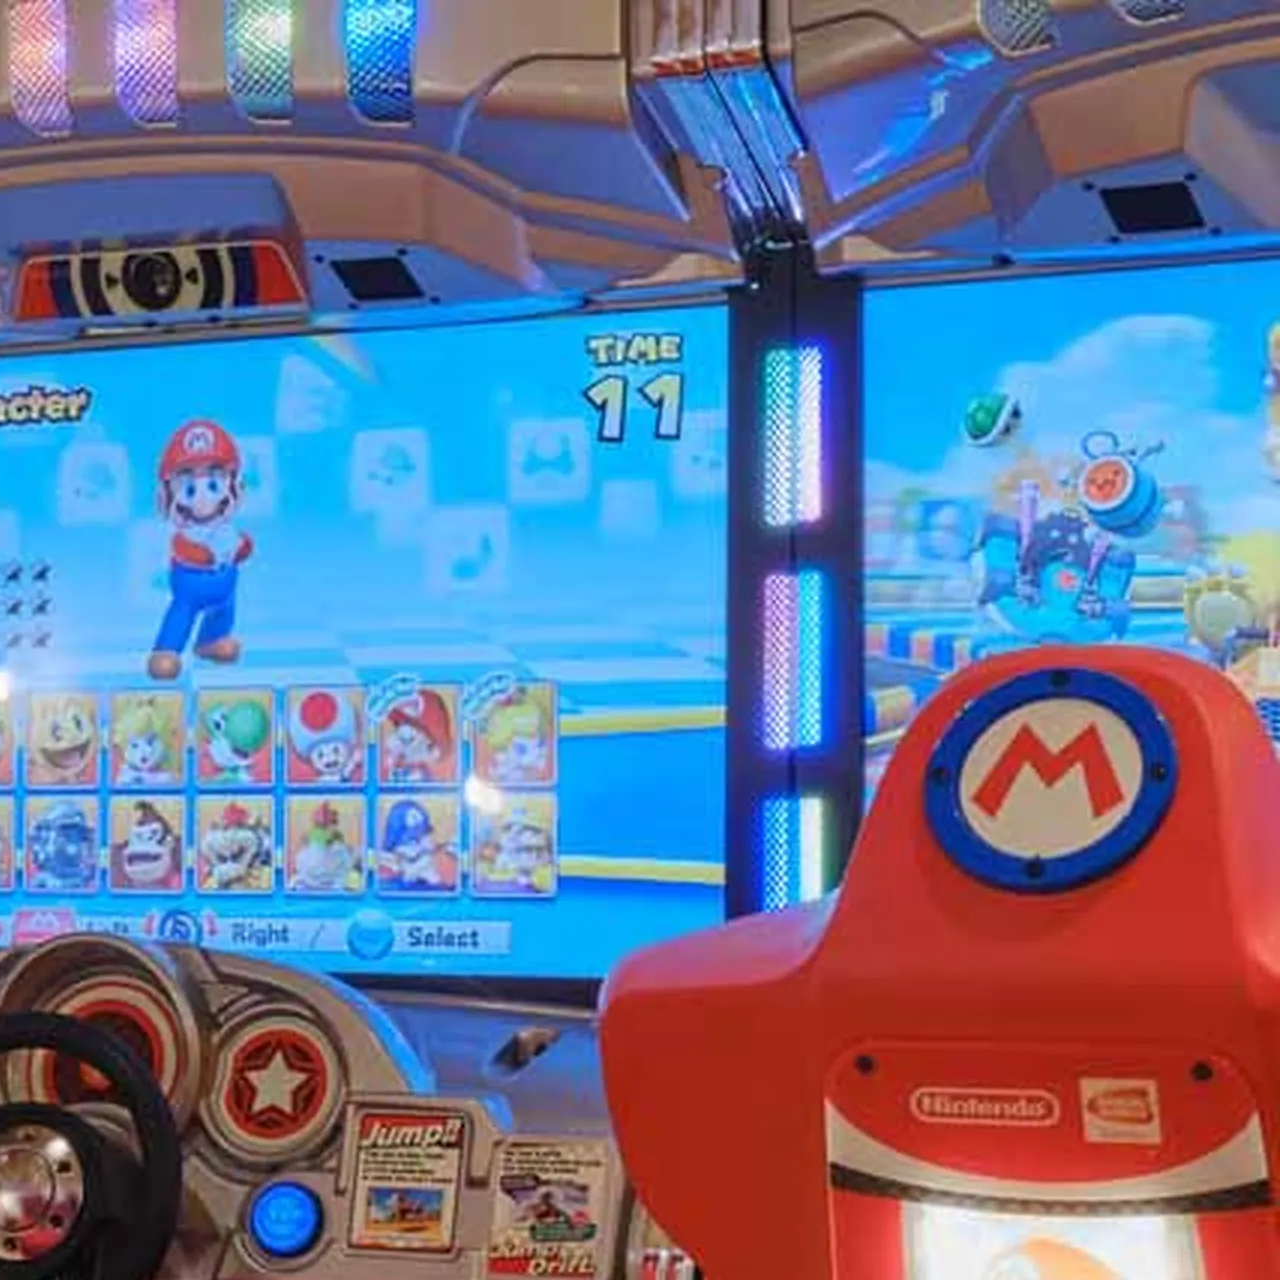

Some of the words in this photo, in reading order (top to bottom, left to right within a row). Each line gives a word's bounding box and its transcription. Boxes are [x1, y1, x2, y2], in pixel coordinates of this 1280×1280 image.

[585, 332, 683, 367] TIME
[583, 370, 683, 442] 11
[972, 720, 1126, 820] M
[231, 920, 290, 947] Right
[406, 924, 481, 949] Select
[920, 1092, 1047, 1119] Nintendo
